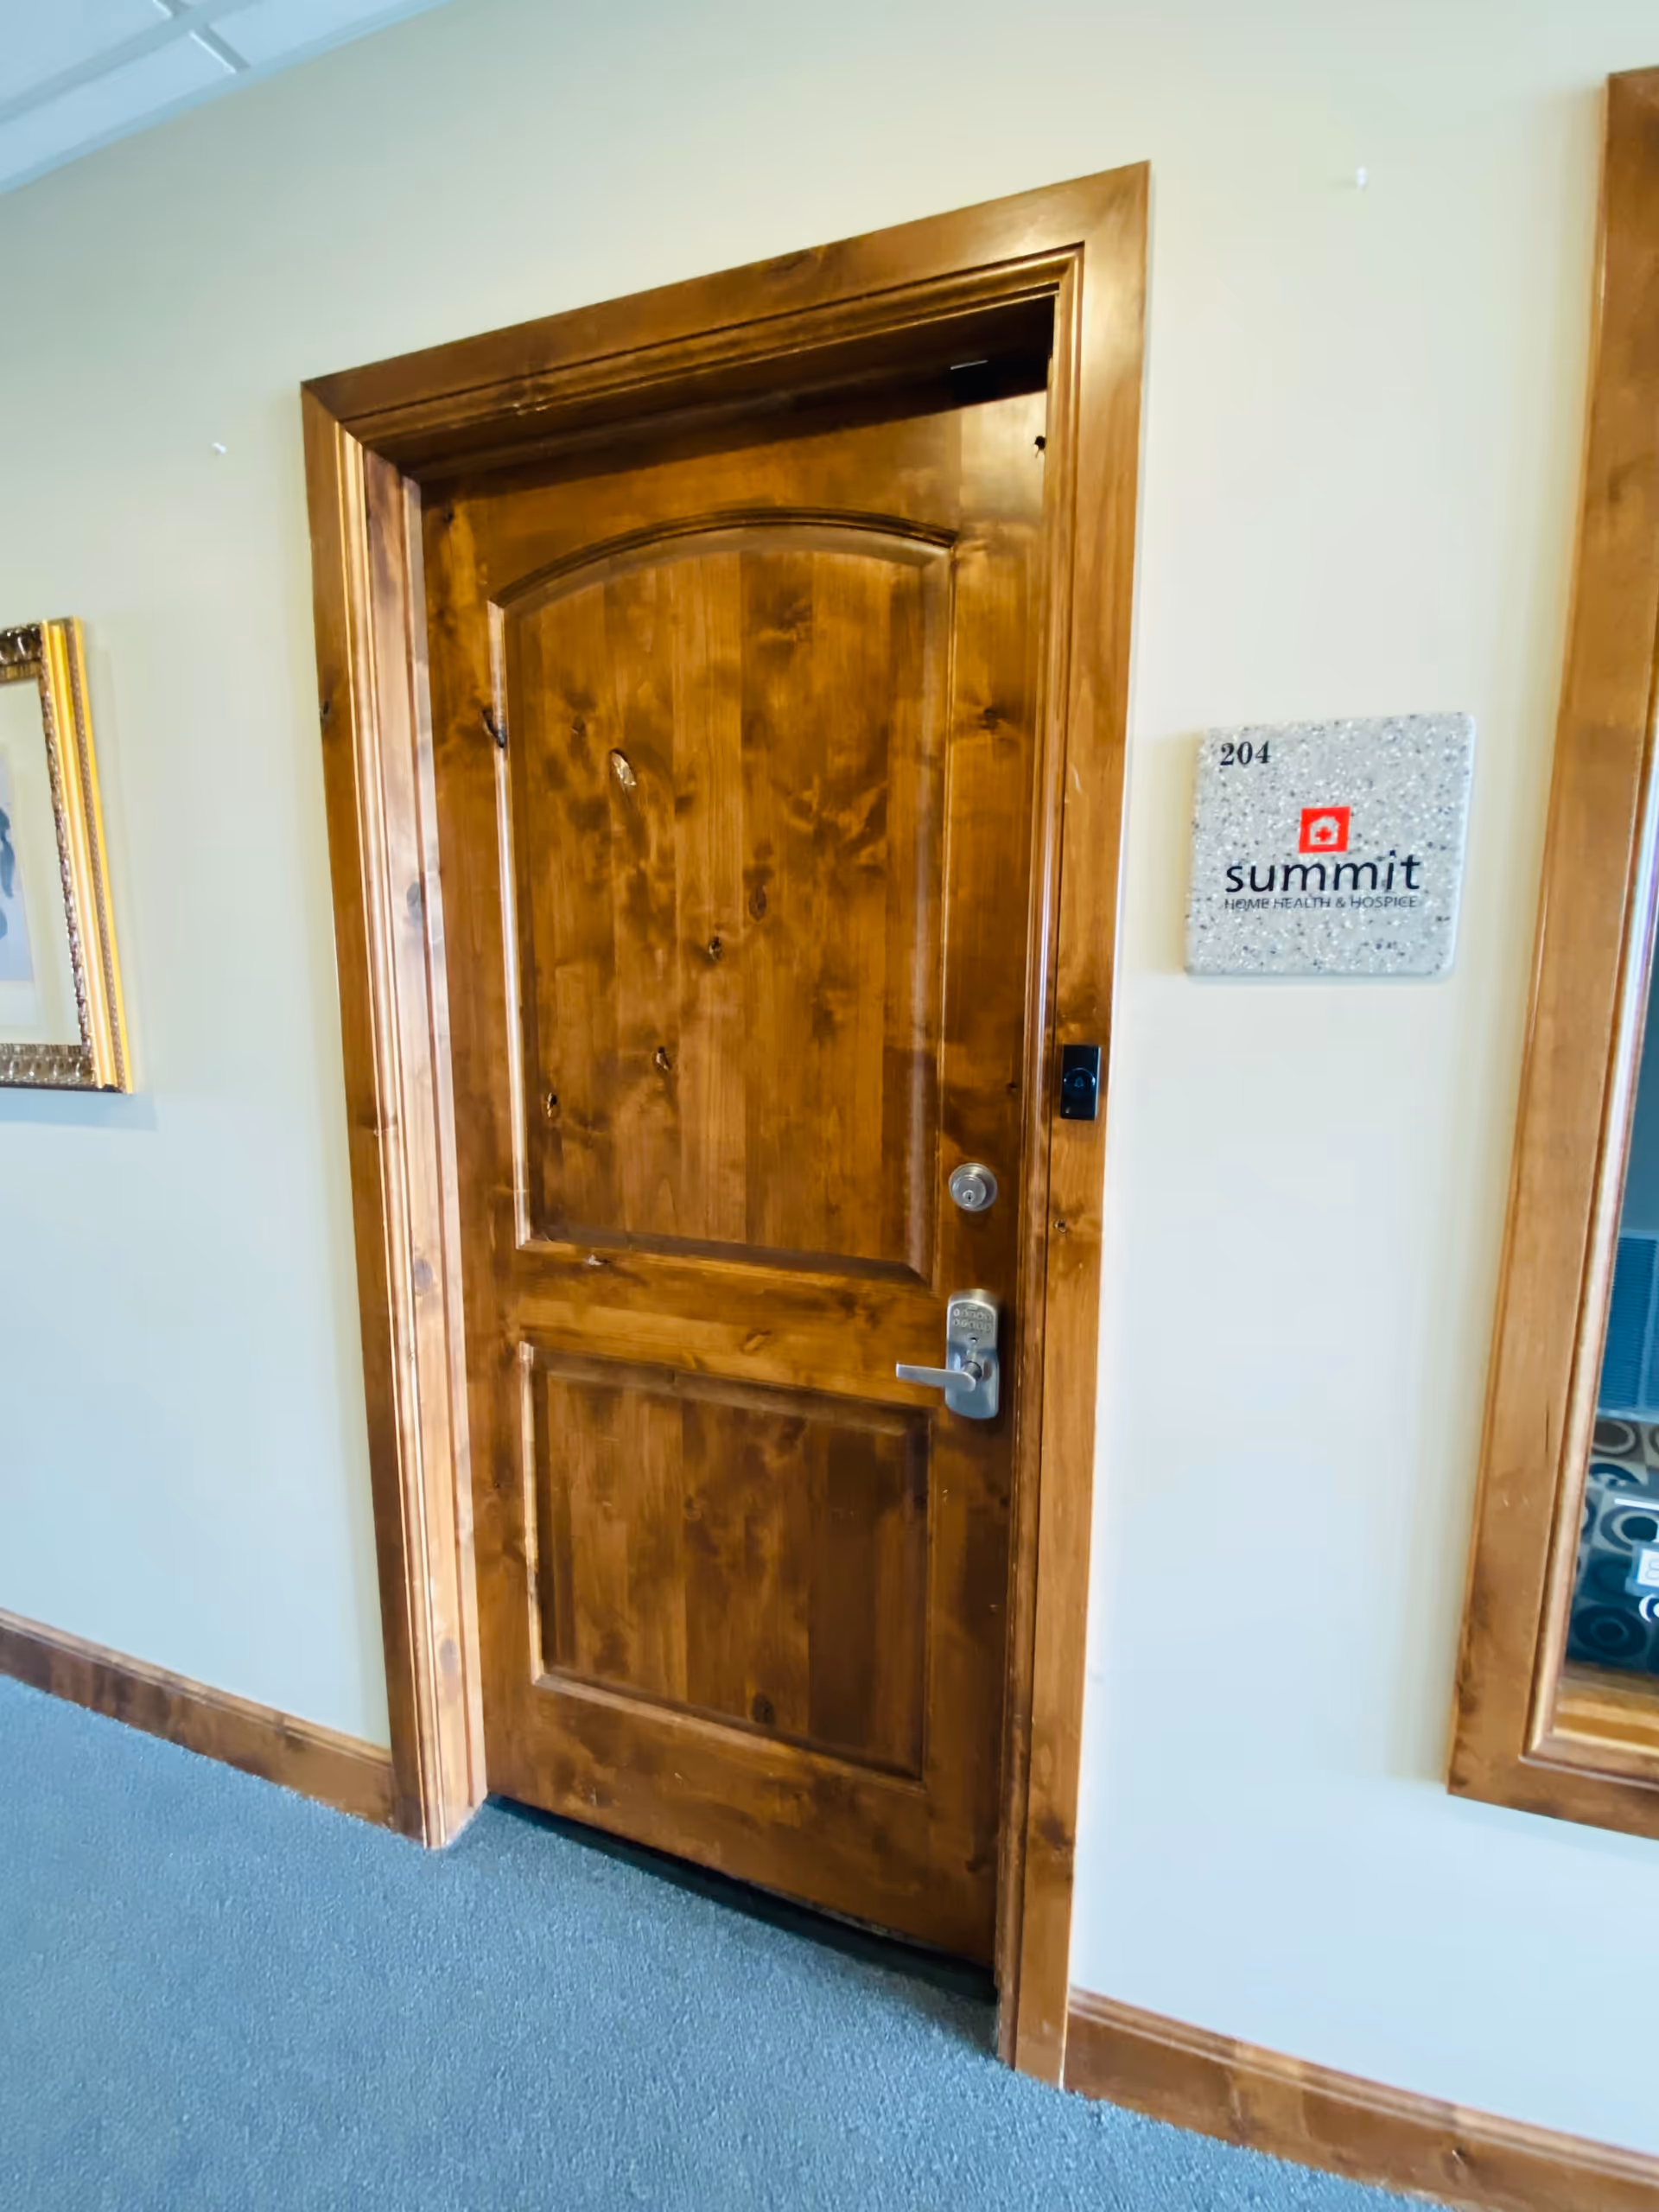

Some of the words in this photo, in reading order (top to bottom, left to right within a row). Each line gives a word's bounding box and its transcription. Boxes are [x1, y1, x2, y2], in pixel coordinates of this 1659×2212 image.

[1219, 741, 1271, 766] 204
[1225, 850, 1421, 893] summit
[1224, 898, 1269, 909] HOME
[1273, 897, 1331, 909] HEALTH
[1337, 897, 1345, 908] &
[1351, 896, 1418, 908] HOSPICE
